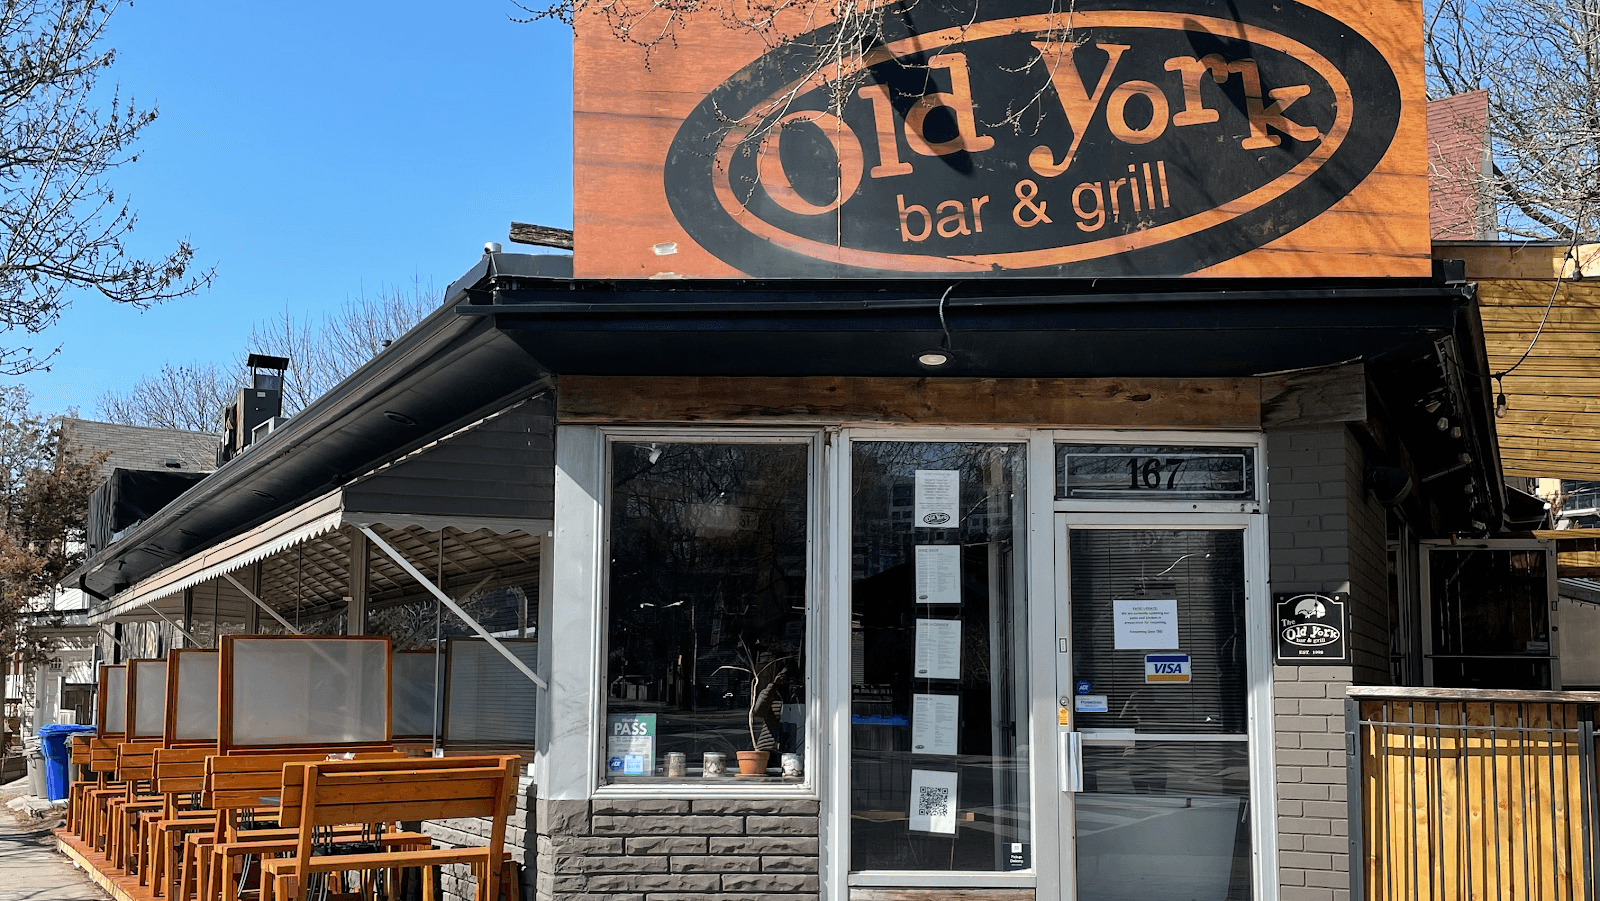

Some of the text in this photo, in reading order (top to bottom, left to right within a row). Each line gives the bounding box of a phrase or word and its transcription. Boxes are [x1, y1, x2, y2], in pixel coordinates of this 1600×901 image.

[756, 40, 1320, 216] Old York
[896, 160, 1171, 242] bar & grill
[1126, 458, 1184, 490] 167
[1281, 618, 1296, 627] The
[1286, 625, 1338, 640] Old York
[1153, 663, 1182, 674] VISA
[614, 722, 647, 736] PASS
